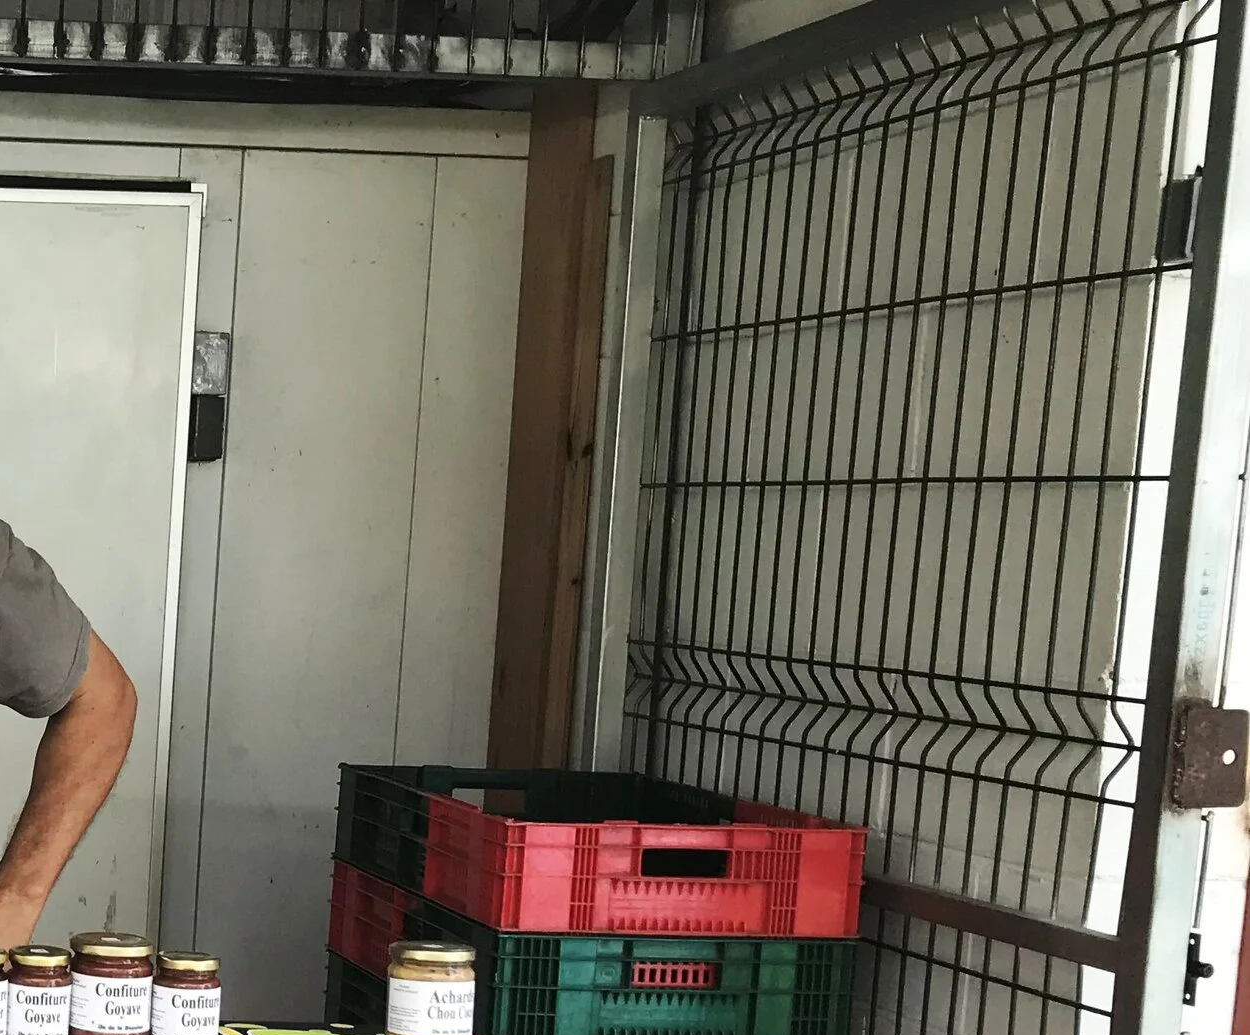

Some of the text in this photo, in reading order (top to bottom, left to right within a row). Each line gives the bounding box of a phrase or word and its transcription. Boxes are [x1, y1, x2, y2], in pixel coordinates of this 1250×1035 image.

[16, 989, 67, 1006] Confiture
[95, 982, 148, 998] Confiture
[25, 1008, 61, 1028] Goyave
[105, 1000, 142, 1020] Goyave
[427, 1004, 456, 1020] Chou
[181, 1011, 216, 1031] Goyave
